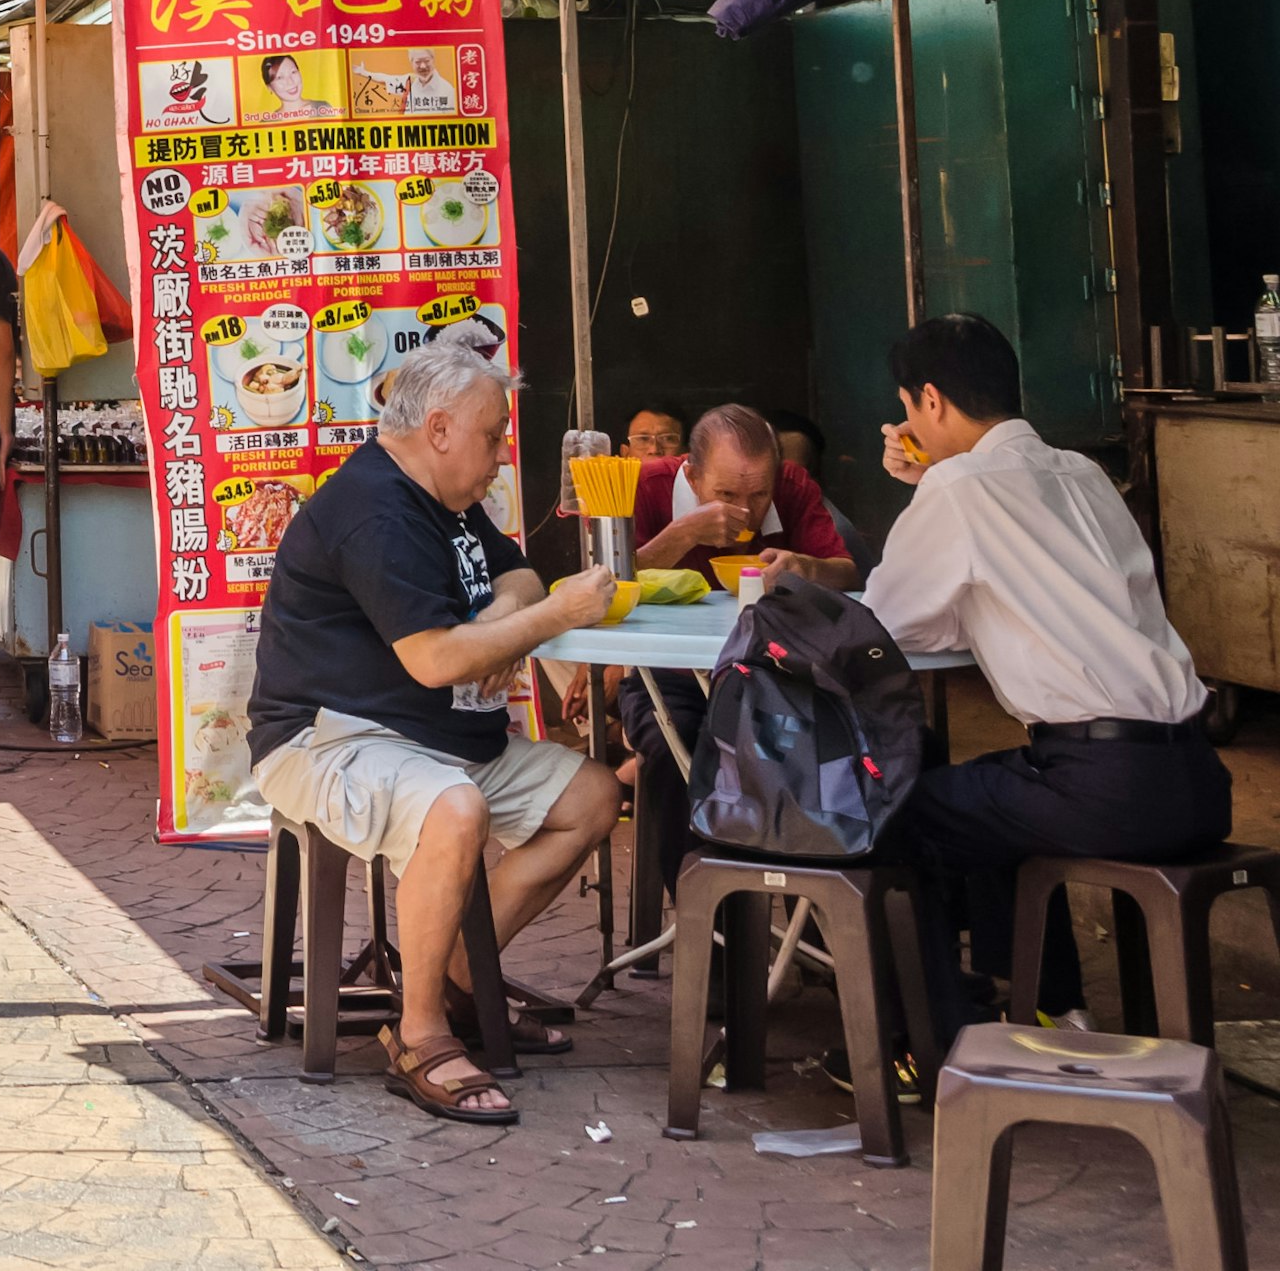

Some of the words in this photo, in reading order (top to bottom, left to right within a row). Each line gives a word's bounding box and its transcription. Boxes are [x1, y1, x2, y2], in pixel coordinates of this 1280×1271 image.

[236, 29, 317, 52] Since
[325, 23, 387, 48] 1949
[146, 117, 161, 129] HO
[164, 115, 199, 127] CHAK!
[244, 113, 260, 122] 3rd
[262, 109, 316, 121] Generation
[318, 107, 346, 116] Owner
[294, 128, 365, 153] BEWARE
[370, 126, 392, 147] OF
[397, 123, 491, 148] IMITATION
[202, 151, 487, 186] 源自一九四九年祖傳秘方
[146, 173, 180, 196] NO
[151, 192, 185, 210] MSG
[196, 189, 219, 214] RM7
[200, 258, 309, 281] 馳名生魚片粥
[408, 272, 433, 282] HOME
[435, 271, 456, 281] MADE
[457, 270, 480, 280] PORK
[481, 269, 502, 279] BALL
[201, 282, 245, 294] FRESH
[249, 279, 278, 290] RAW
[282, 276, 312, 288] FISH
[317, 274, 354, 286] CRISPY
[357, 273, 400, 284] INNARDS
[436, 281, 476, 293] PORRIDGE
[223, 289, 292, 304] PORRIDGE
[333, 285, 384, 297] PORRIDGE
[205, 316, 242, 344] RM18
[395, 331, 420, 353] OR
[224, 450, 266, 462] FRESH
[270, 448, 304, 459] FROG
[315, 445, 354, 456] TENDER
[232, 460, 298, 473] PORRIDGE
[227, 582, 254, 593] SECRET
[255, 582, 270, 592] REC
[115, 651, 153, 677] Sea
